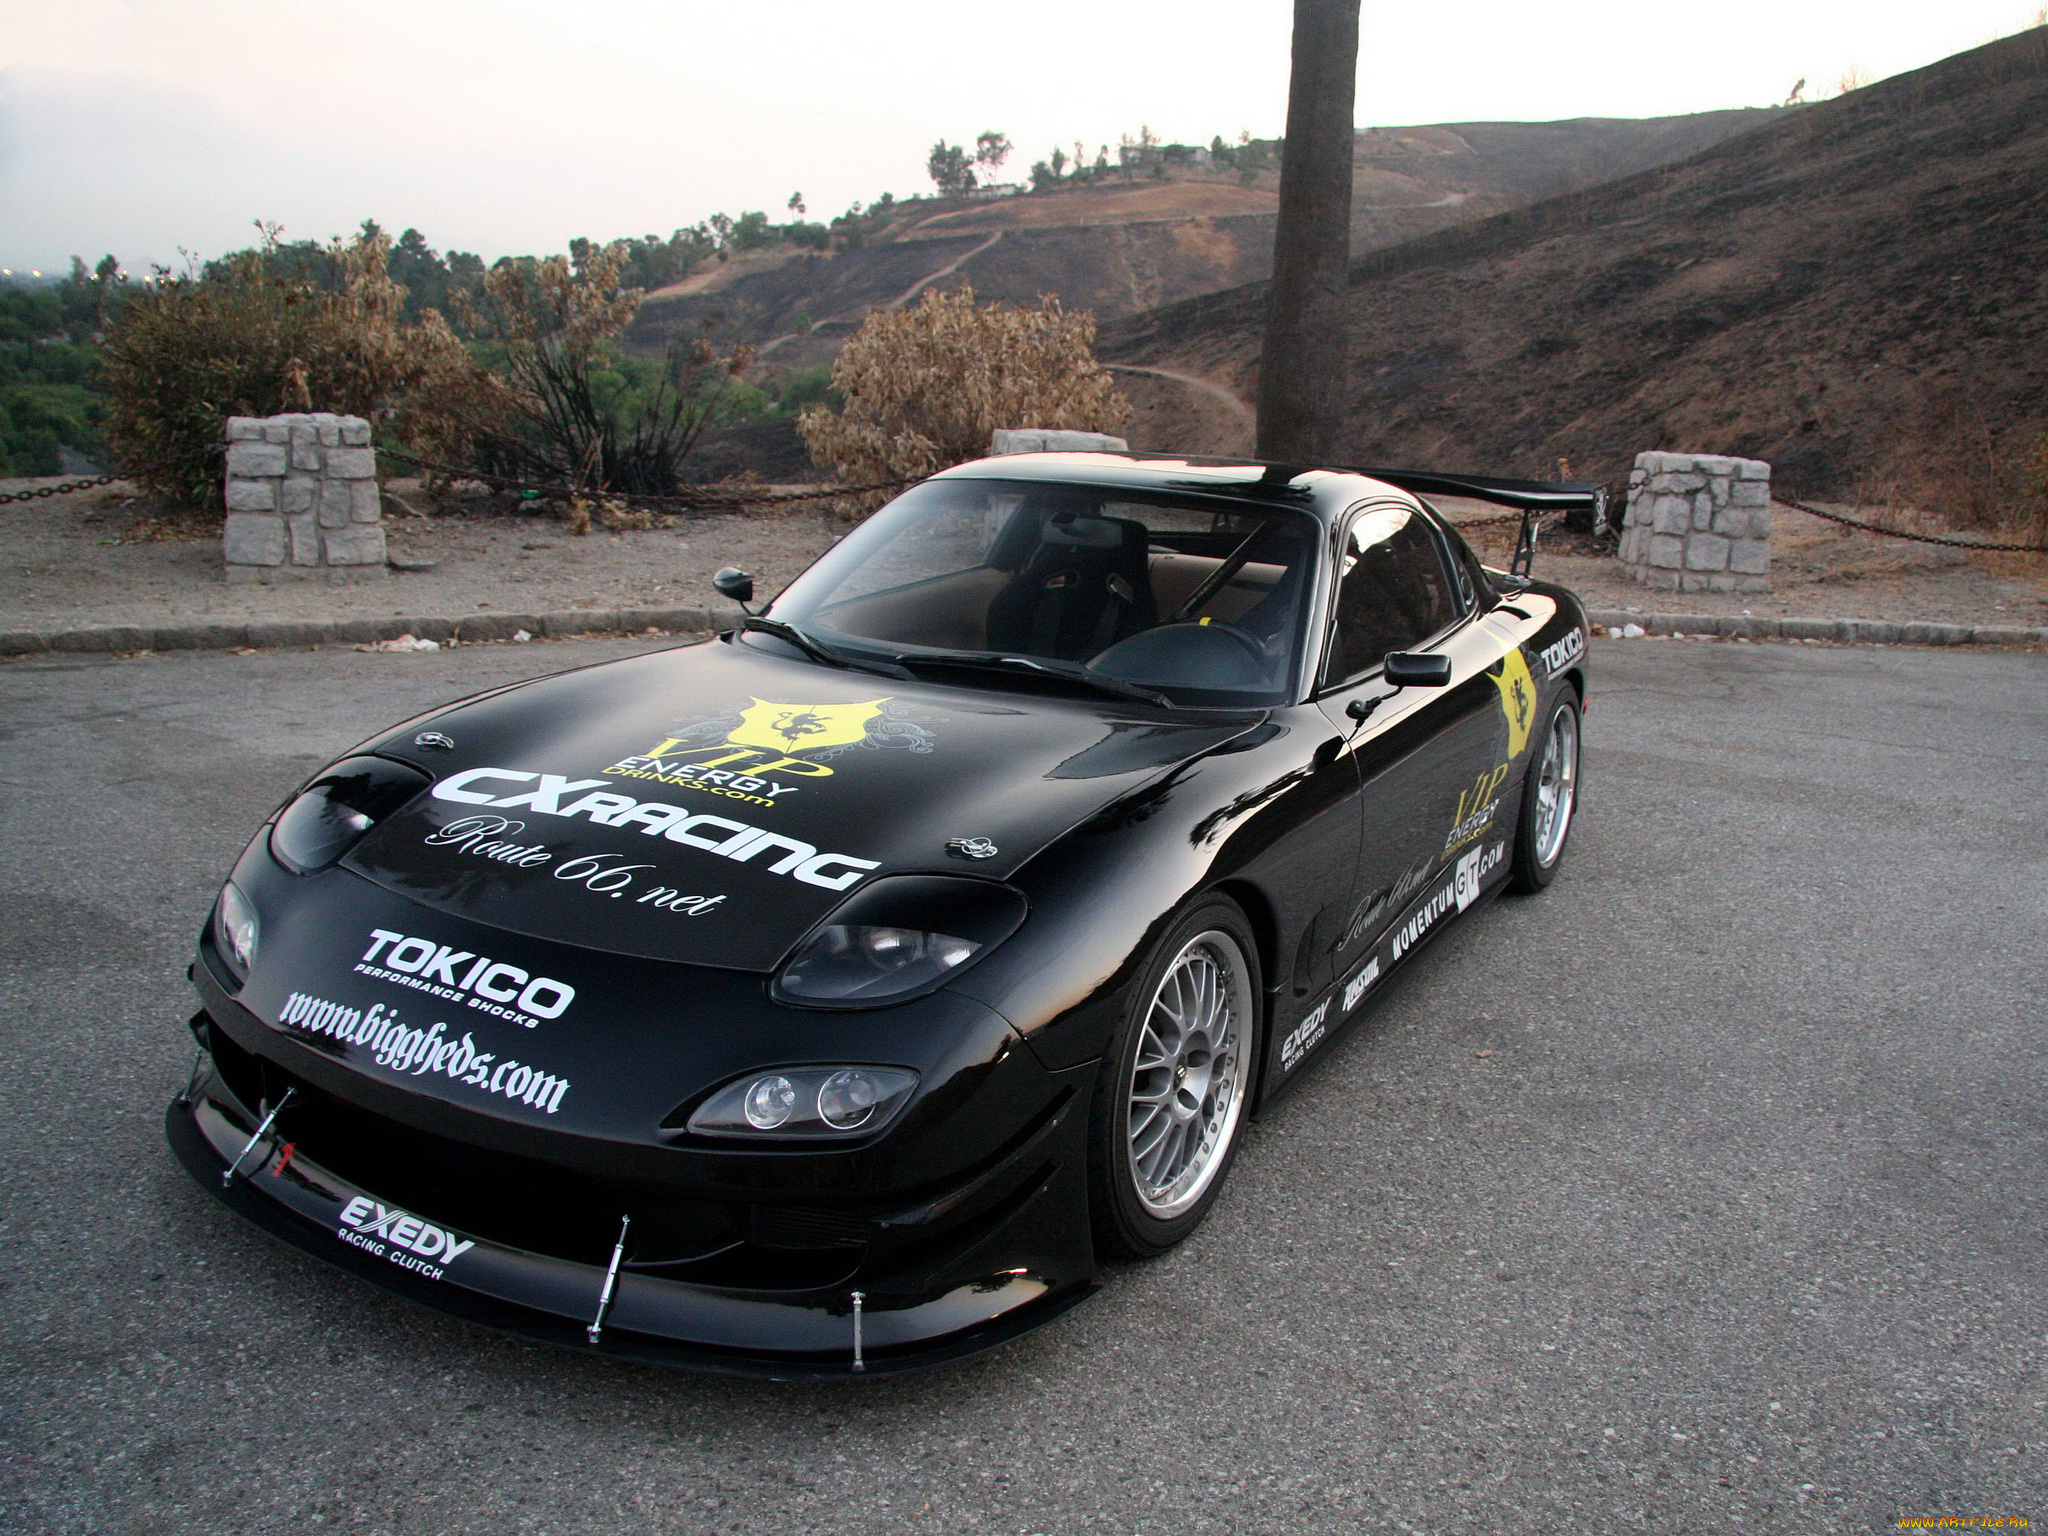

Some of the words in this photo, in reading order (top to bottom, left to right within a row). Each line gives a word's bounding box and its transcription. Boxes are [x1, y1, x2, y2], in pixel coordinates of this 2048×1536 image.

[1541, 626, 1584, 674] TOKICO
[601, 766, 776, 808] DRINKS.com
[614, 756, 799, 798] ENERGY
[638, 737, 835, 778] VIP
[1445, 798, 1500, 850] ENERGY
[1453, 763, 1509, 829] VIP
[424, 815, 552, 868] Route
[432, 767, 882, 891] CXRACING
[354, 963, 464, 1003] PERFORMANCE
[468, 997, 539, 1029] SHOCKS
[362, 928, 575, 1020] TOKICO
[279, 991, 571, 1114] www.biggheds.com
[1281, 995, 1332, 1062] EXEDY
[338, 1228, 386, 1257] RACING
[389, 1251, 444, 1280] CLUTCH
[339, 1196, 475, 1265] EXEDY
